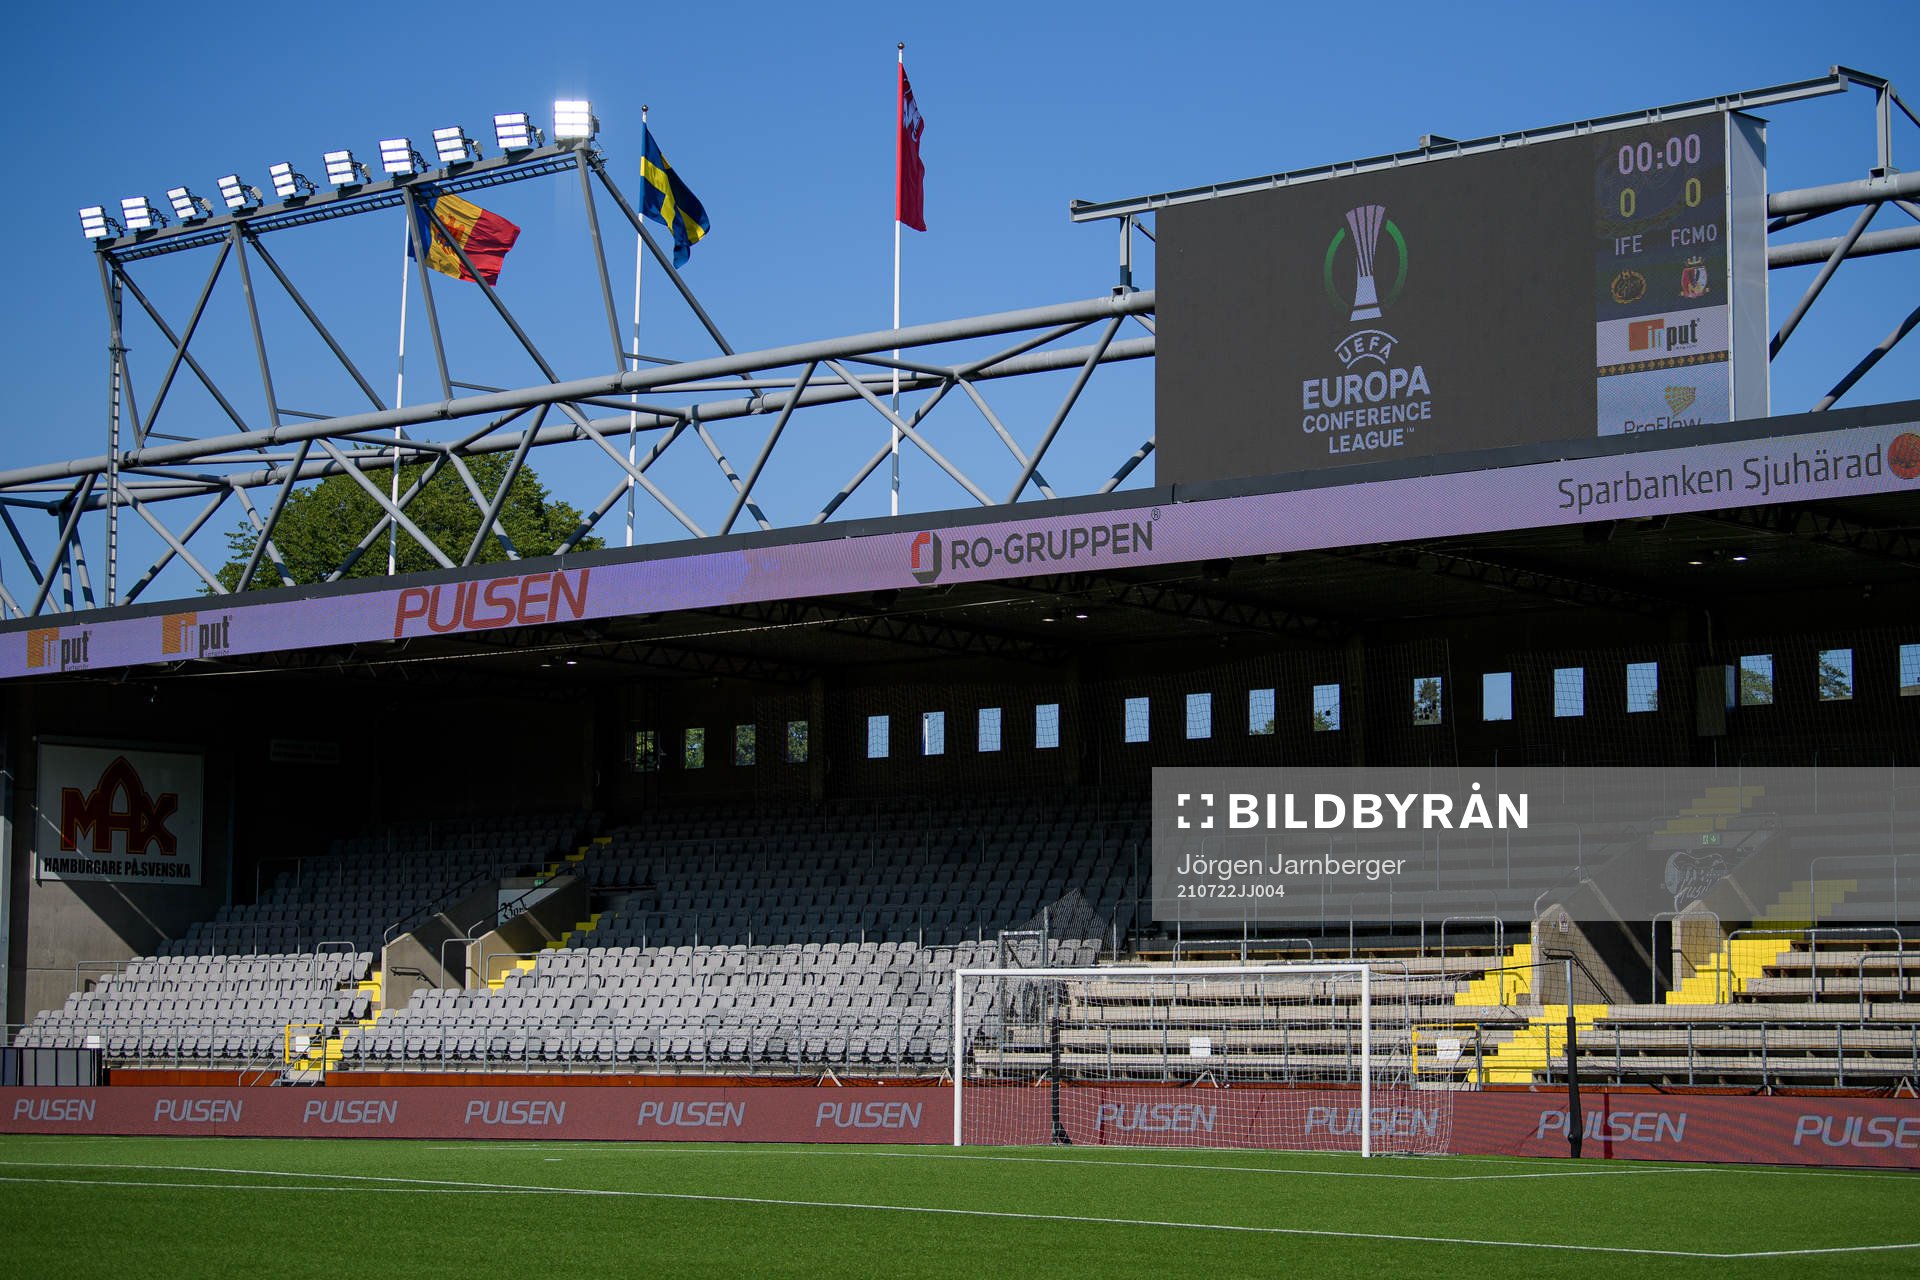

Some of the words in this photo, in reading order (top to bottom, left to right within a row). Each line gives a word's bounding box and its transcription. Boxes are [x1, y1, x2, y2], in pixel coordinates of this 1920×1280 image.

[1618, 133, 1701, 174] 00:00
[1619, 187, 1636, 217] 0
[1685, 177, 1701, 207] 0
[1615, 234, 1643, 255] IFE
[1671, 223, 1718, 247] FCMO
[1338, 336, 1391, 363] UEFA
[1302, 365, 1431, 410] EUROPA
[1302, 401, 1432, 433] CONFERENCE
[1328, 428, 1404, 454] LEAGUE
[1559, 464, 1733, 514] Sparbanken
[1743, 443, 1882, 496] Sjuhärad
[951, 520, 1153, 570] RO-GRUPPEN
[394, 568, 589, 637] PULSEN
[60, 755, 178, 856] MAX
[44, 857, 122, 876] HAMBURGARE
[124, 857, 139, 876] PÅ
[140, 860, 191, 878] SVENSKA
[13, 1099, 96, 1121] PULSEN
[154, 1099, 243, 1122] PULSEN
[303, 1100, 398, 1124] PULSEN
[464, 1100, 566, 1125] PULSEN
[637, 1101, 746, 1127] PULSEN
[815, 1102, 923, 1129] PULSEN
[1095, 1103, 1217, 1132] PULSEN
